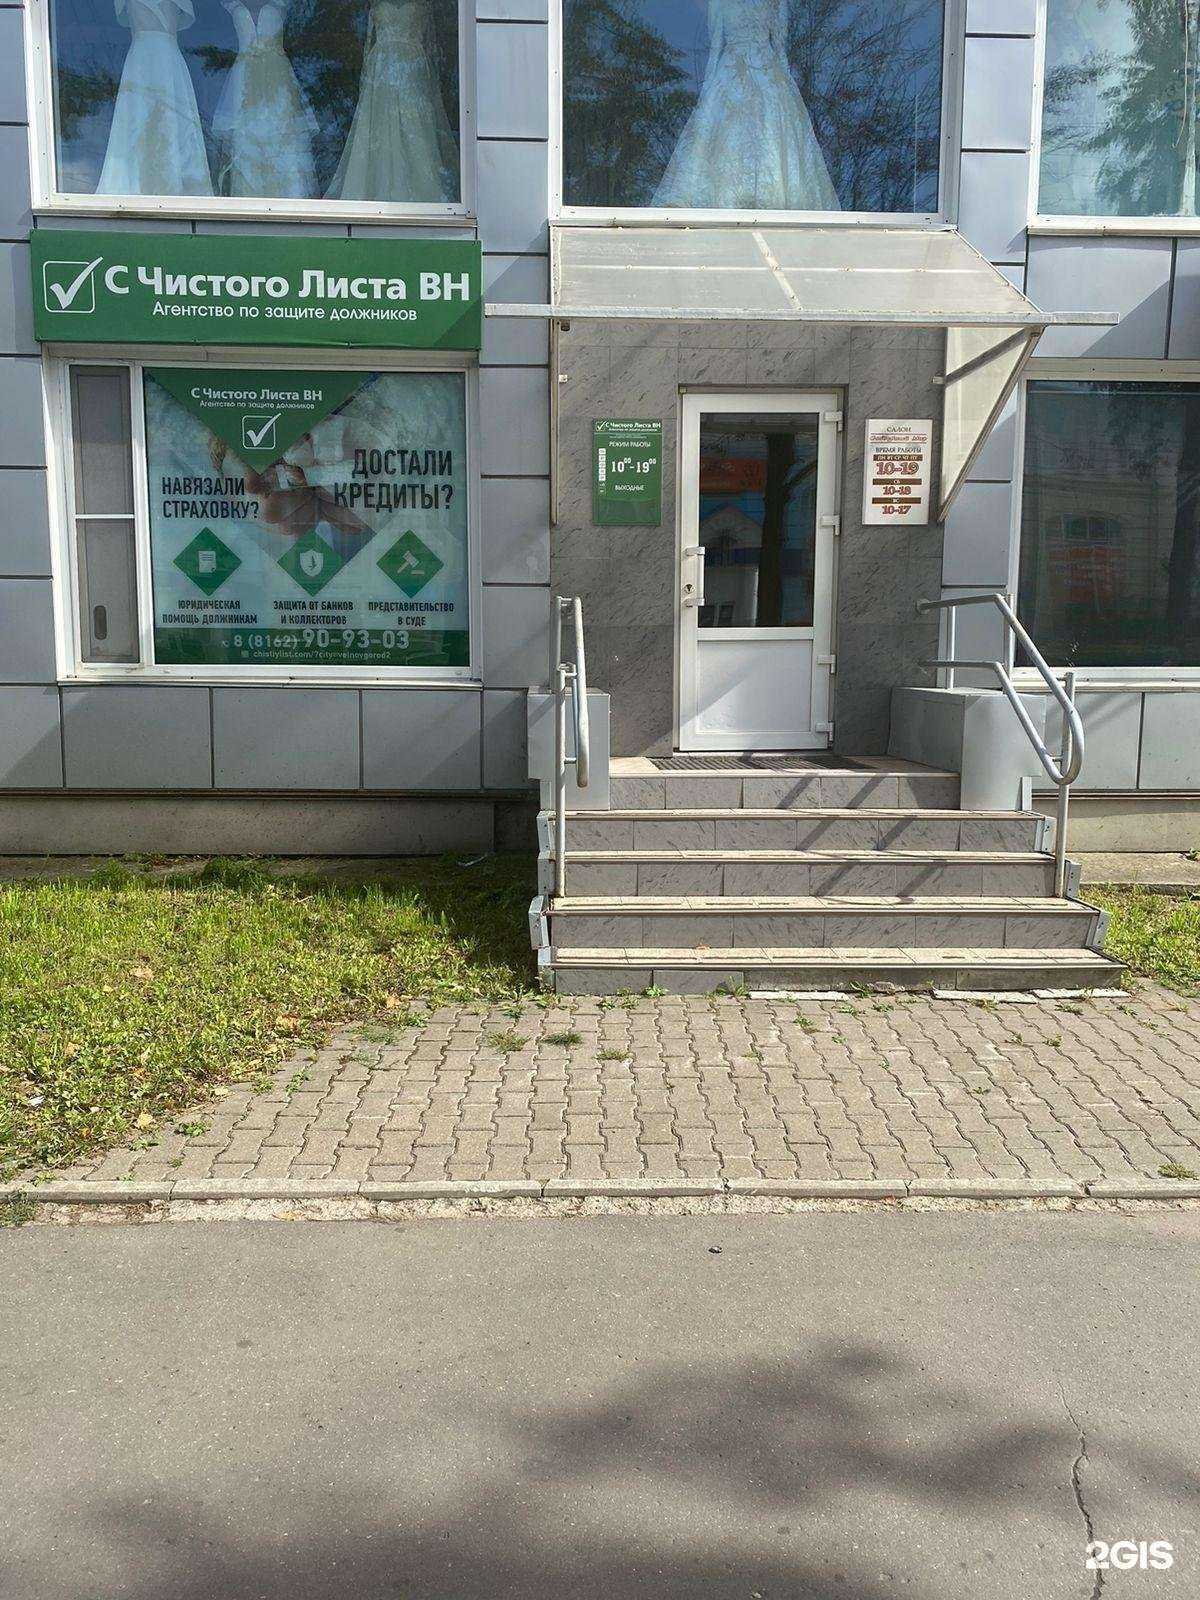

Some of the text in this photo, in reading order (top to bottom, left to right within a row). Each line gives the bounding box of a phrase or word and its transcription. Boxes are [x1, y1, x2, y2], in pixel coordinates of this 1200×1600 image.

[104, 266, 470, 301] С Чистого Листа ВН
[153, 301, 417, 321] Агентство по защите должников
[191, 388, 322, 401] С Чистого Листа ВН
[352, 449, 452, 478] ДОСТАЛИ
[876, 461, 919, 475] 10-19
[162, 477, 245, 496] НАВЯЗАЛИ
[614, 484, 645, 492] ВЫХОДНЫЕ
[883, 486, 911, 495] 10-18
[334, 483, 454, 512] КРЕДИТЫ?
[162, 500, 259, 519] СТРАХОВКУ?
[882, 505, 911, 515] 10-17
[178, 600, 240, 610] ЮРИДИЧЕСКАЯ
[273, 601, 354, 612] ЗАЩИТА ОТ БАНКОВ
[368, 602, 454, 613] ПРЕДСТАВИТЕЛЬСТВО
[162, 614, 258, 625] ПОМОЩЬ ДОЛЖНИКАМ
[281, 615, 347, 625] И КОЛЛЕКТОРОВ
[397, 616, 426, 626] В СУДЕ
[234, 629, 410, 649] 8 (8162) 90-93-03
